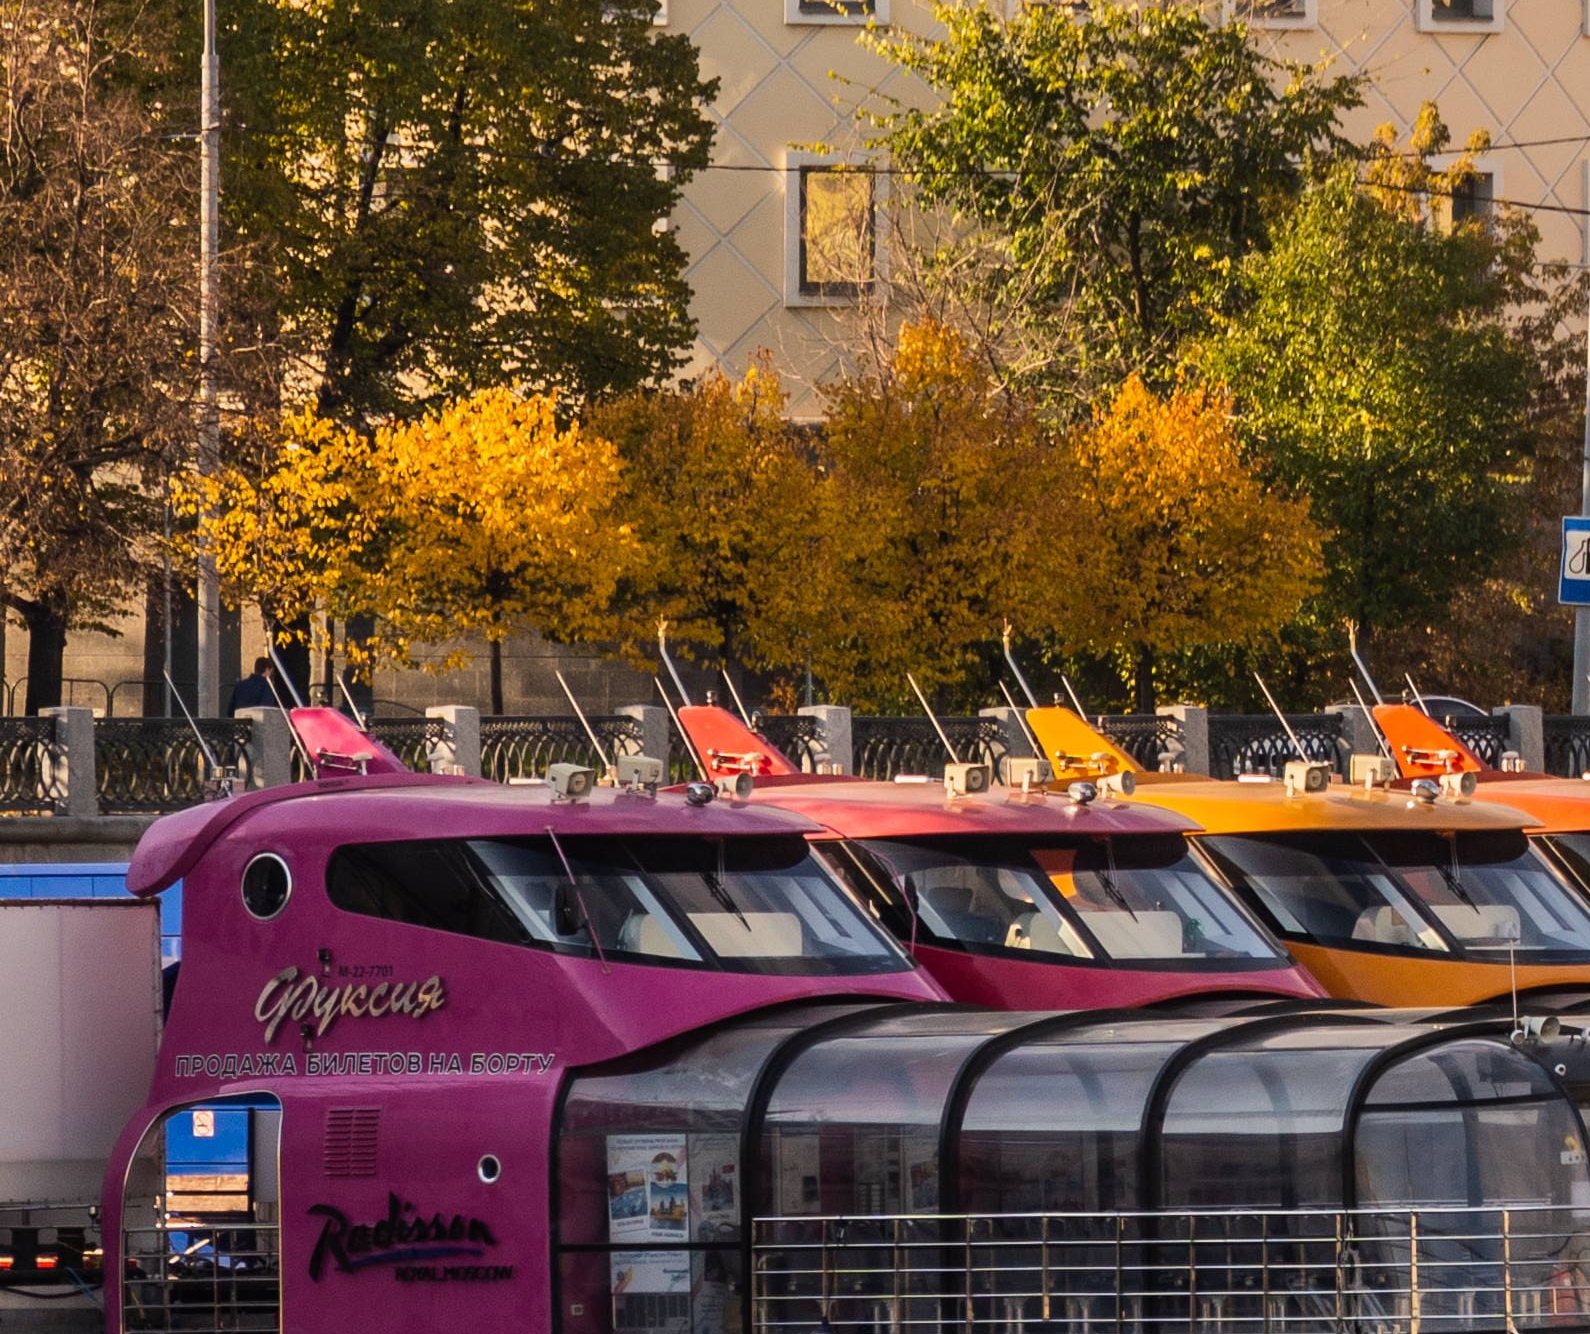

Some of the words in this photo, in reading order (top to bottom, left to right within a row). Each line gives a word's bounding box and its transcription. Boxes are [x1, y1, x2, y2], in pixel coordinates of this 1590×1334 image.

[255, 966, 446, 1043] Фуксия
[175, 1053, 298, 1080] ПРОДАЖА
[306, 1052, 422, 1076] БИЛЕТОВ
[428, 1053, 463, 1075] НА
[470, 1053, 556, 1076] БОРТУ
[306, 1191, 497, 1283] Radisson
